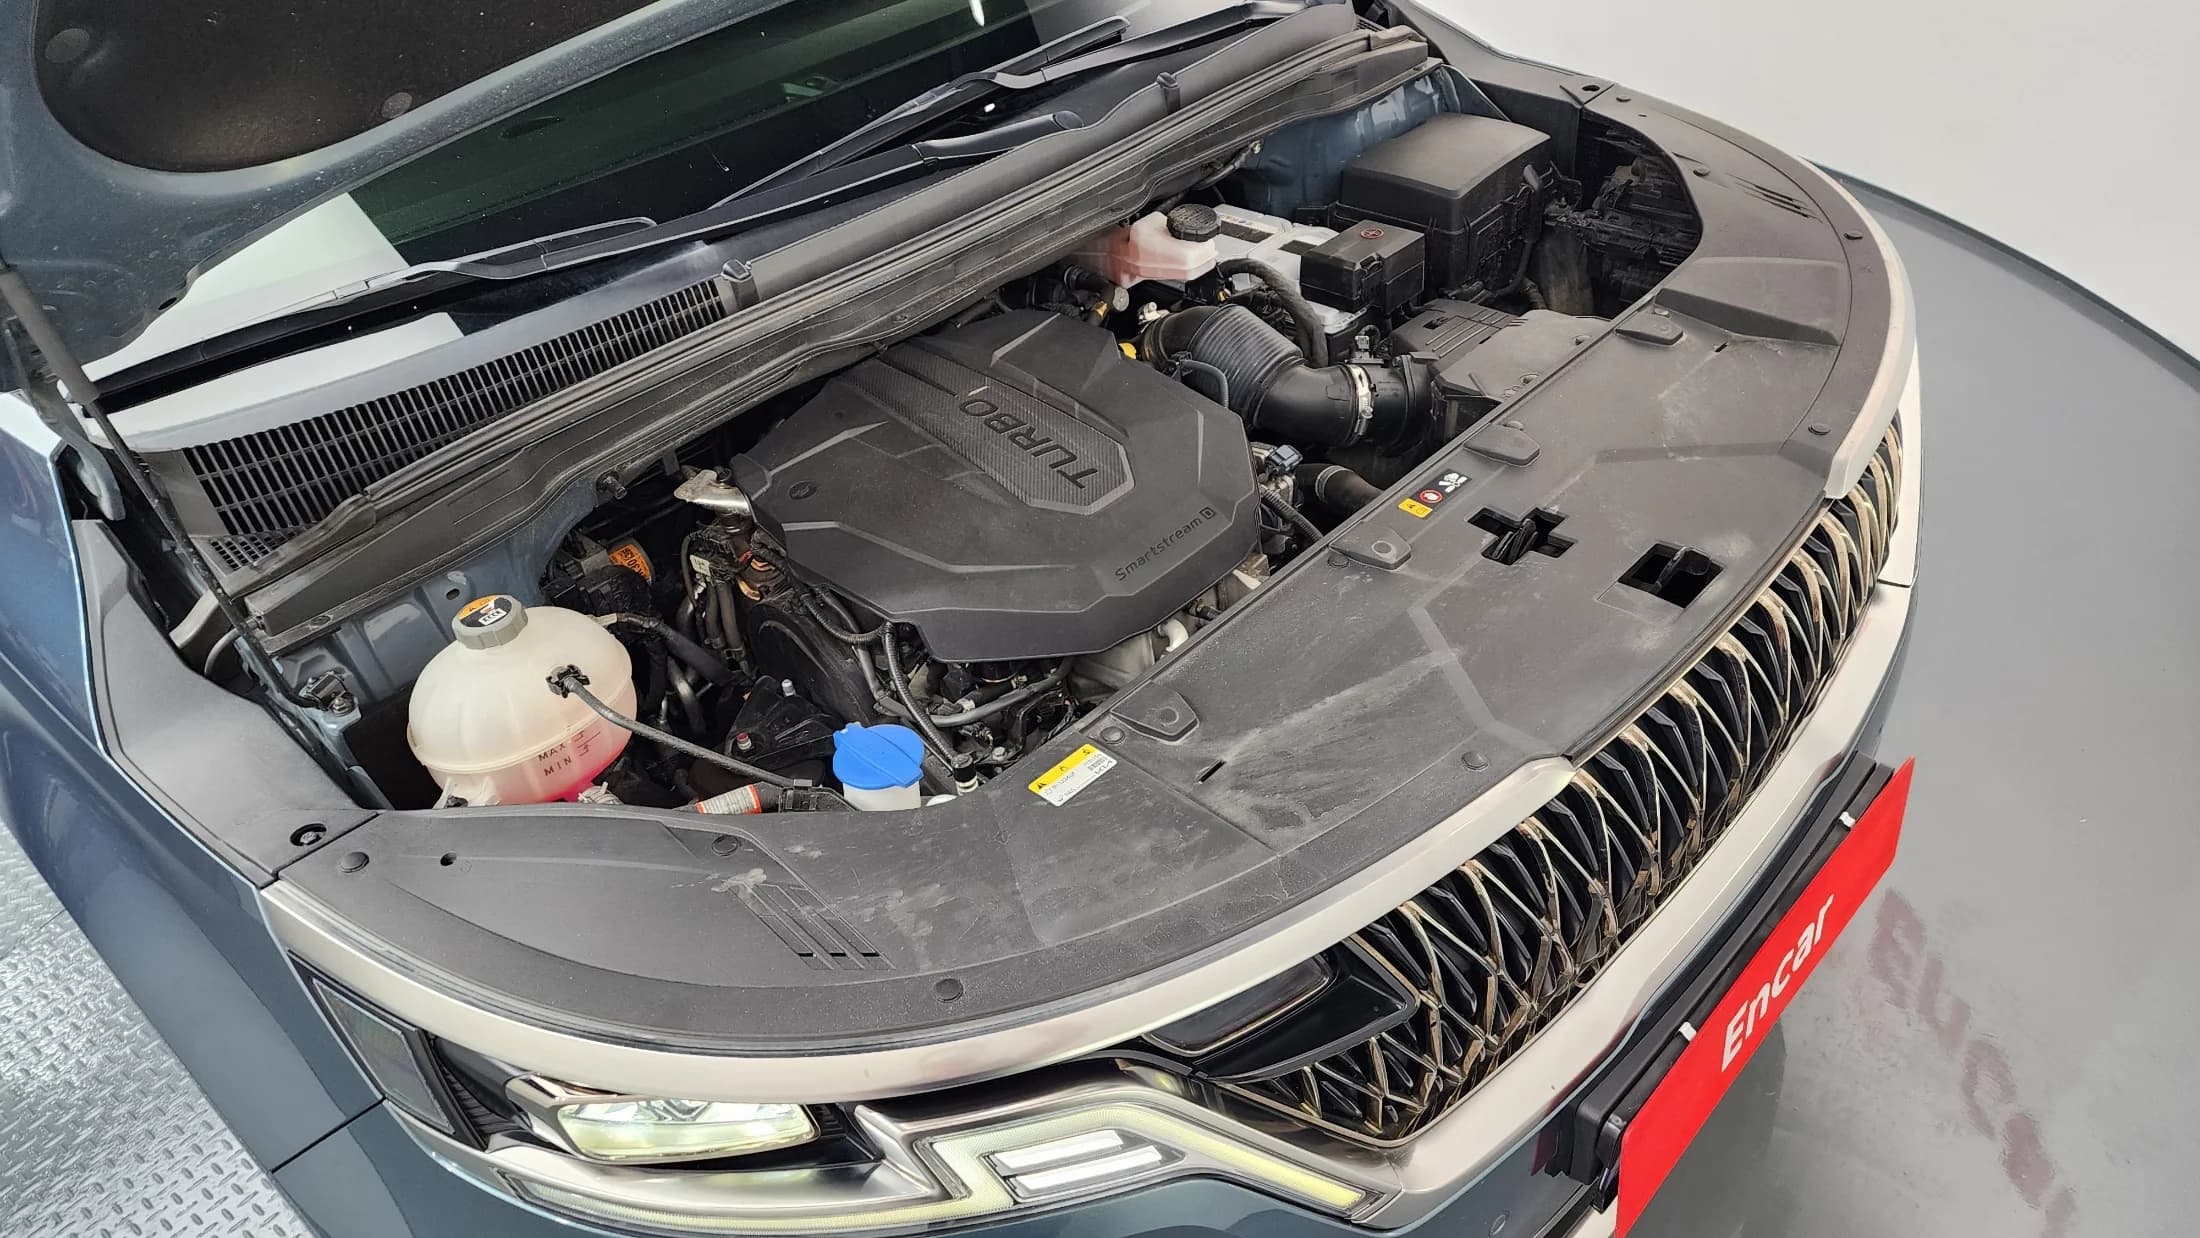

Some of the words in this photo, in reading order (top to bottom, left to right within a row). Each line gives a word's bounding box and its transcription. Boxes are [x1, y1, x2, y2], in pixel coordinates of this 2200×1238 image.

[960, 399, 1098, 489] TURBO
[1115, 517, 1203, 581] Smartstream
[538, 743, 566, 761] MAX
[544, 755, 572, 776] MIN
[1721, 893, 1835, 1073] Encar
